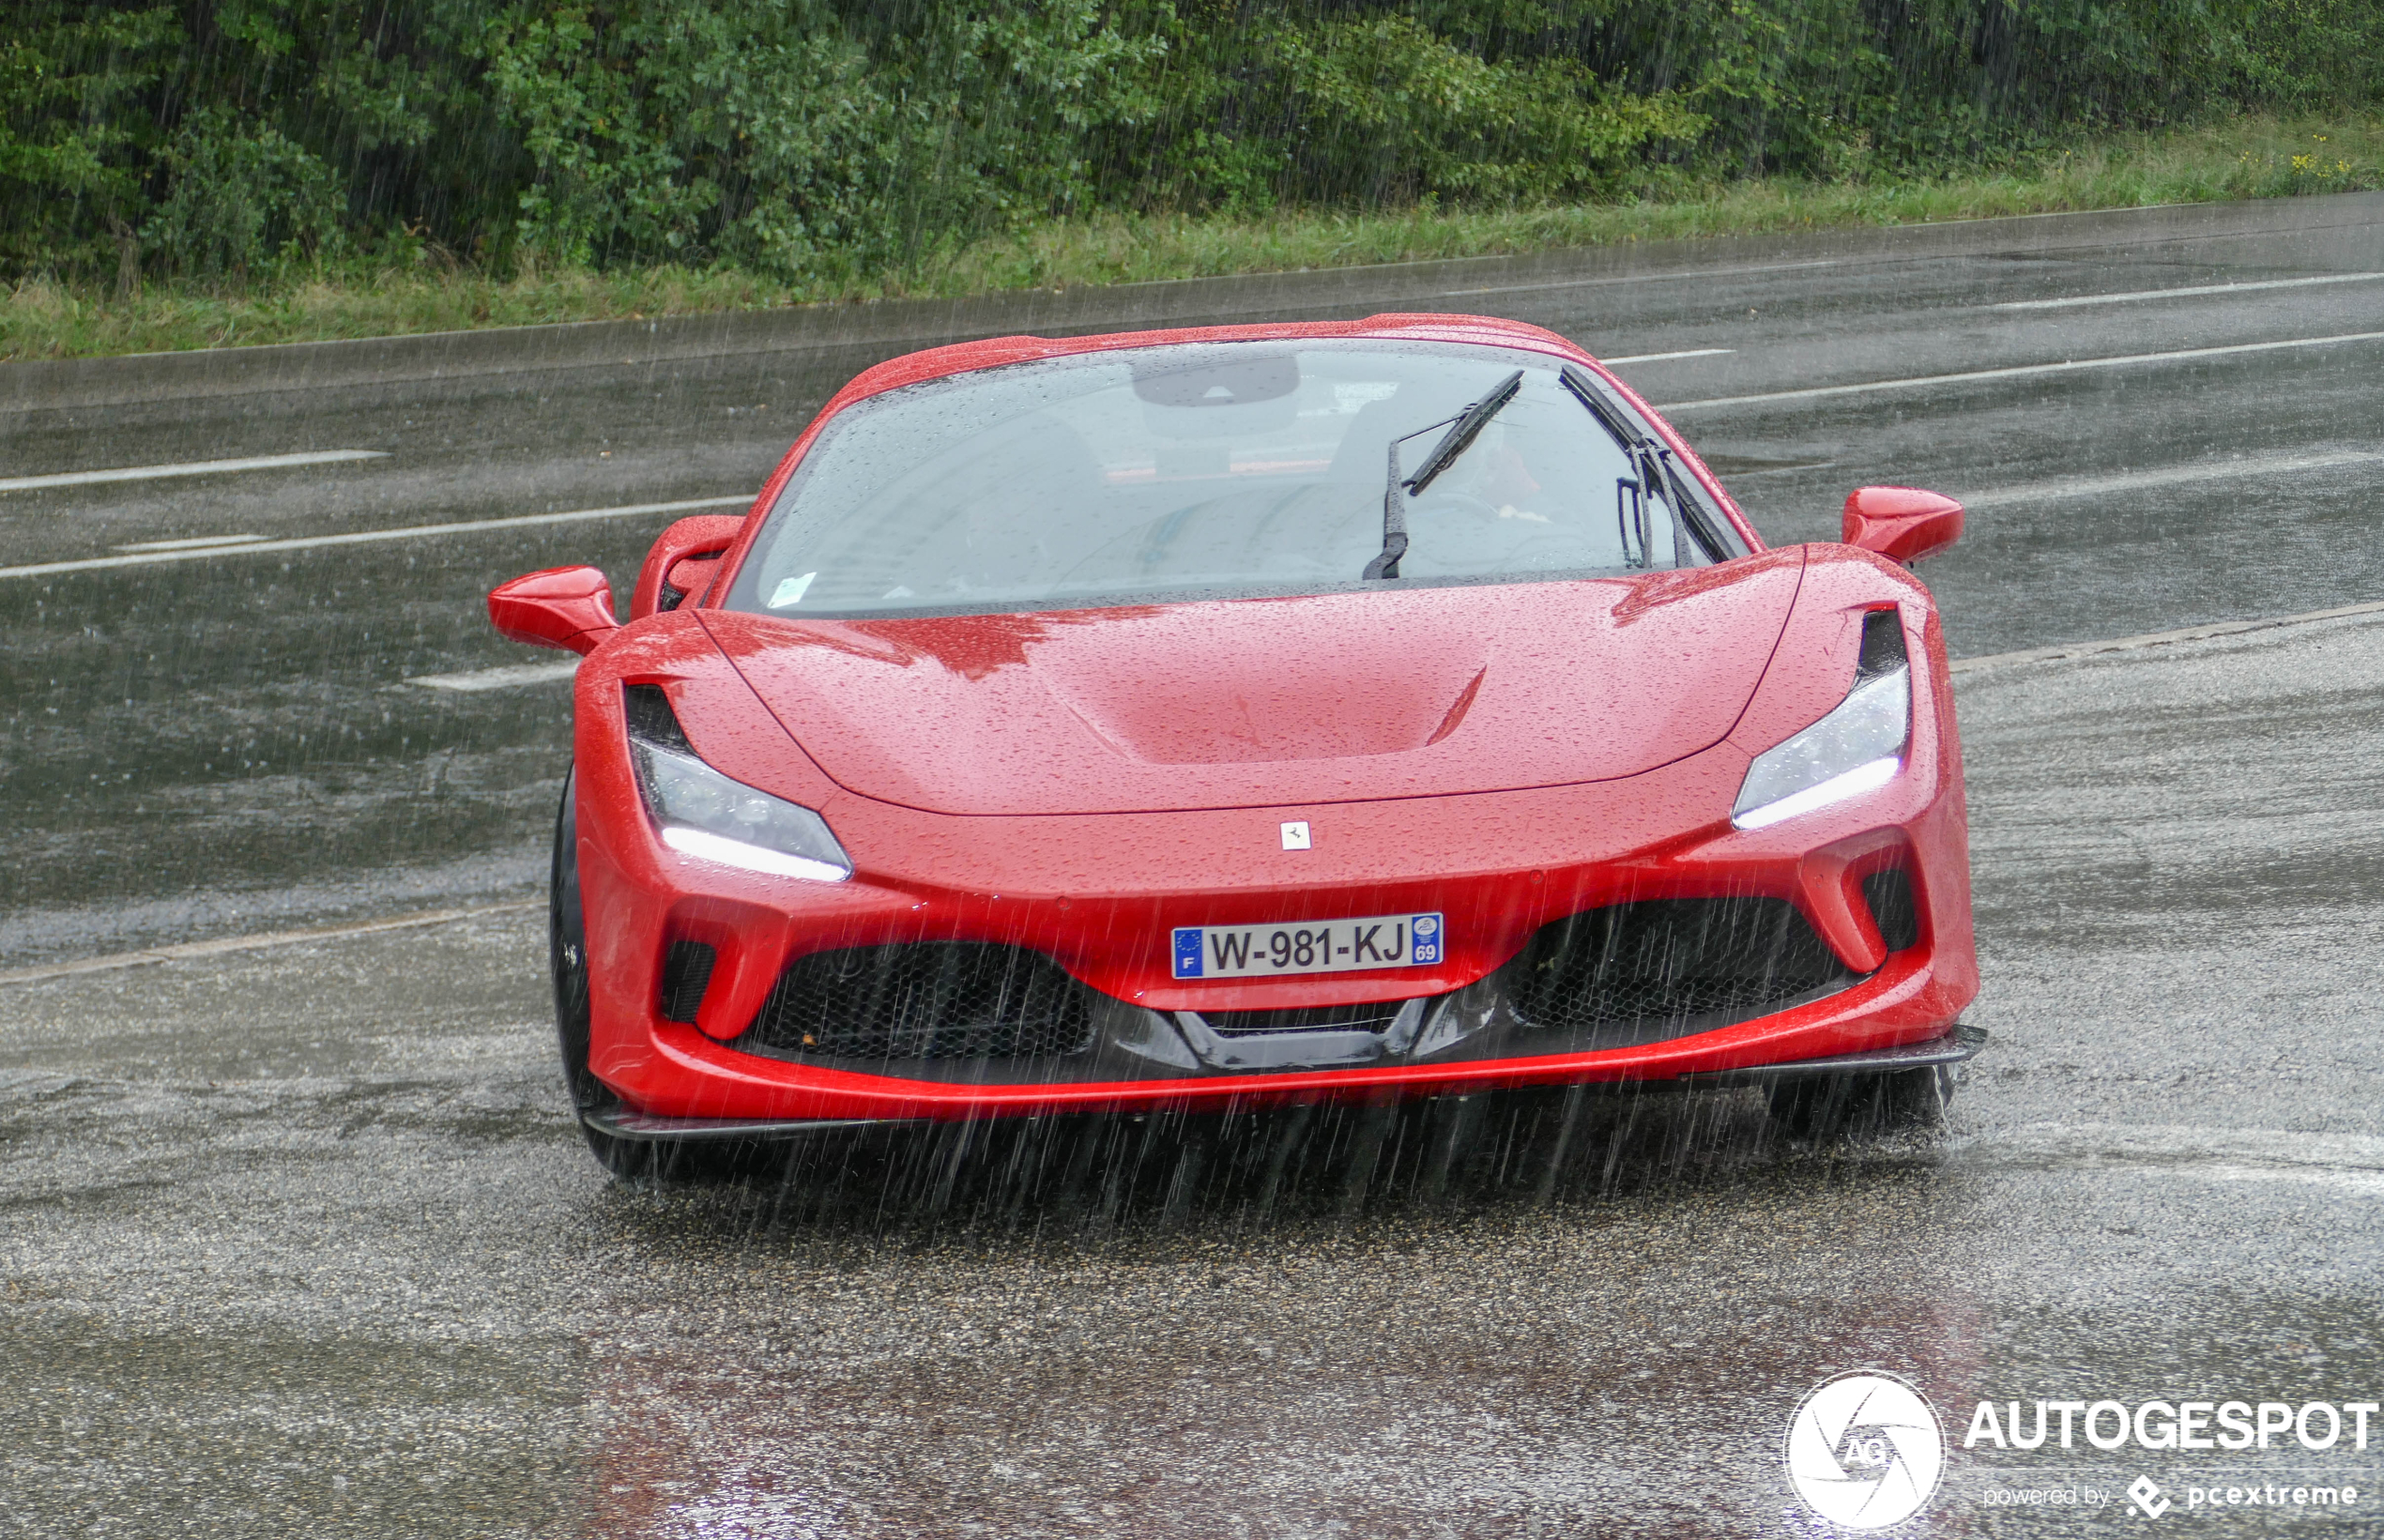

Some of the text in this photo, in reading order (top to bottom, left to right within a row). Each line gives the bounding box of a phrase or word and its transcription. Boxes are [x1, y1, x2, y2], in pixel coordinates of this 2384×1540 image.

[1211, 922, 1404, 969] W-981-KJ
[1415, 944, 1436, 961] 69
[1184, 957, 1195, 968] F
